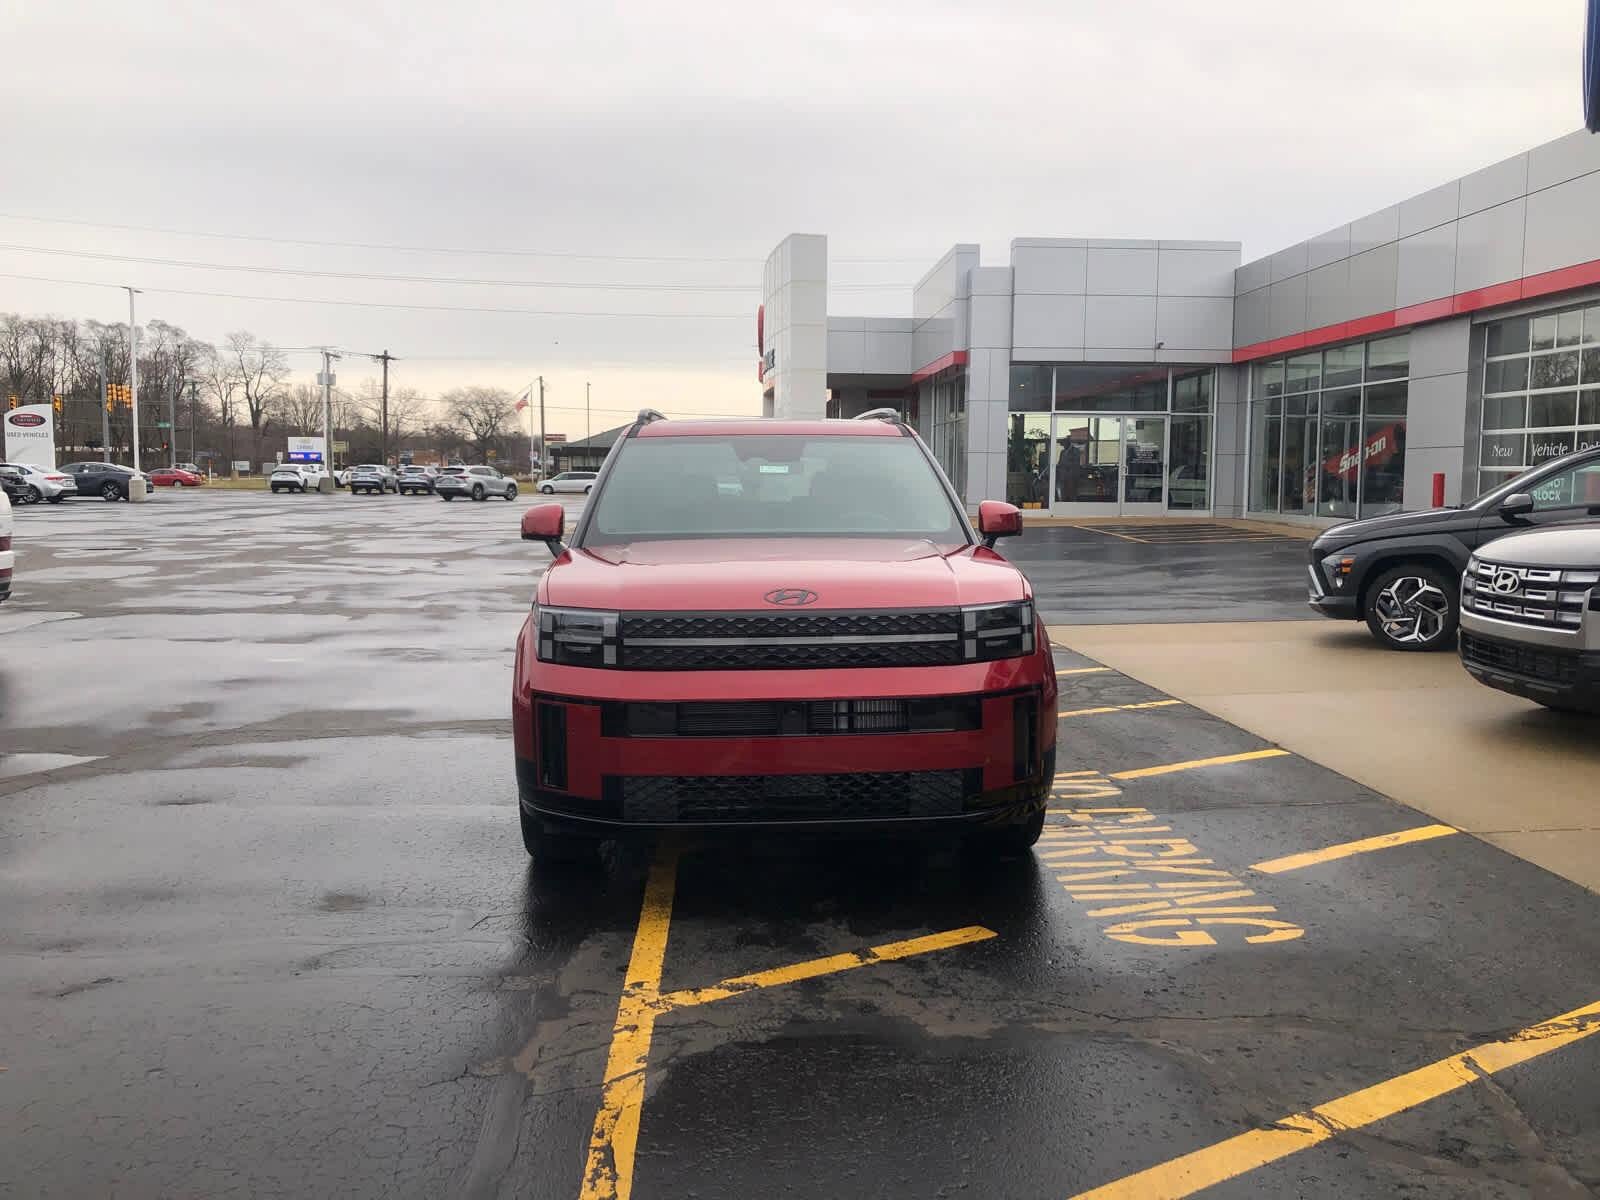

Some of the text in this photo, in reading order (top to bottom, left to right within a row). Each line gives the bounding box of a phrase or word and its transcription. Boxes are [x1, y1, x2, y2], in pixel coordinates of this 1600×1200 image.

[1491, 445, 1514, 457] New
[1531, 442, 1569, 457] Vehicle
[1035, 806, 1305, 946] PARKING
